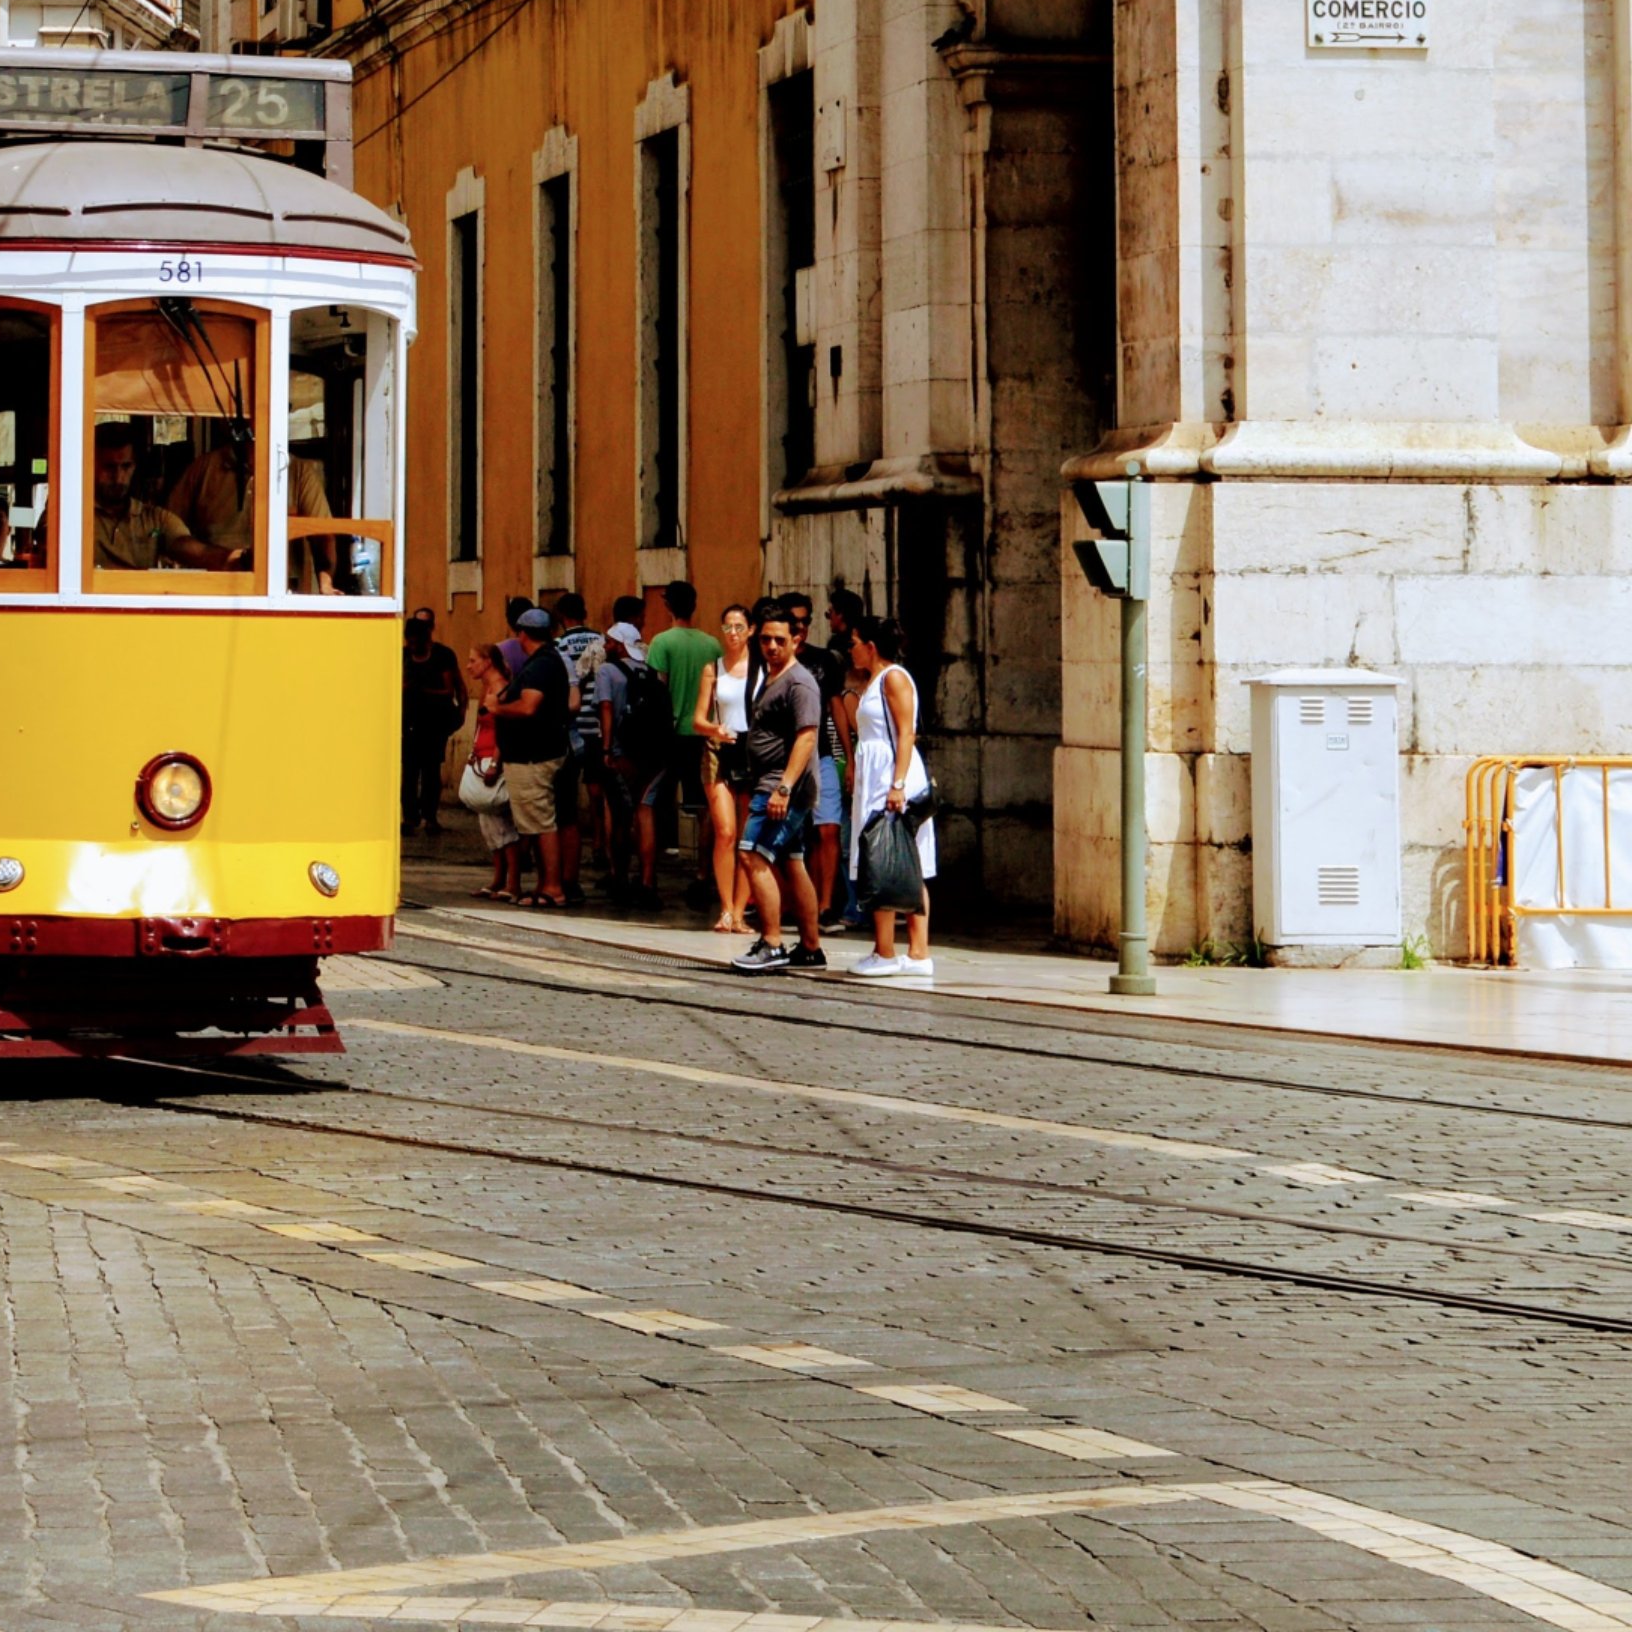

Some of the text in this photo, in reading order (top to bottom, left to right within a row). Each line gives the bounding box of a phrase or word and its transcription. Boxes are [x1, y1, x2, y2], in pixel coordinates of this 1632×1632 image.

[1312, 0, 1426, 19] COMERCIO
[219, 77, 289, 126] 25
[159, 260, 202, 283] 581
